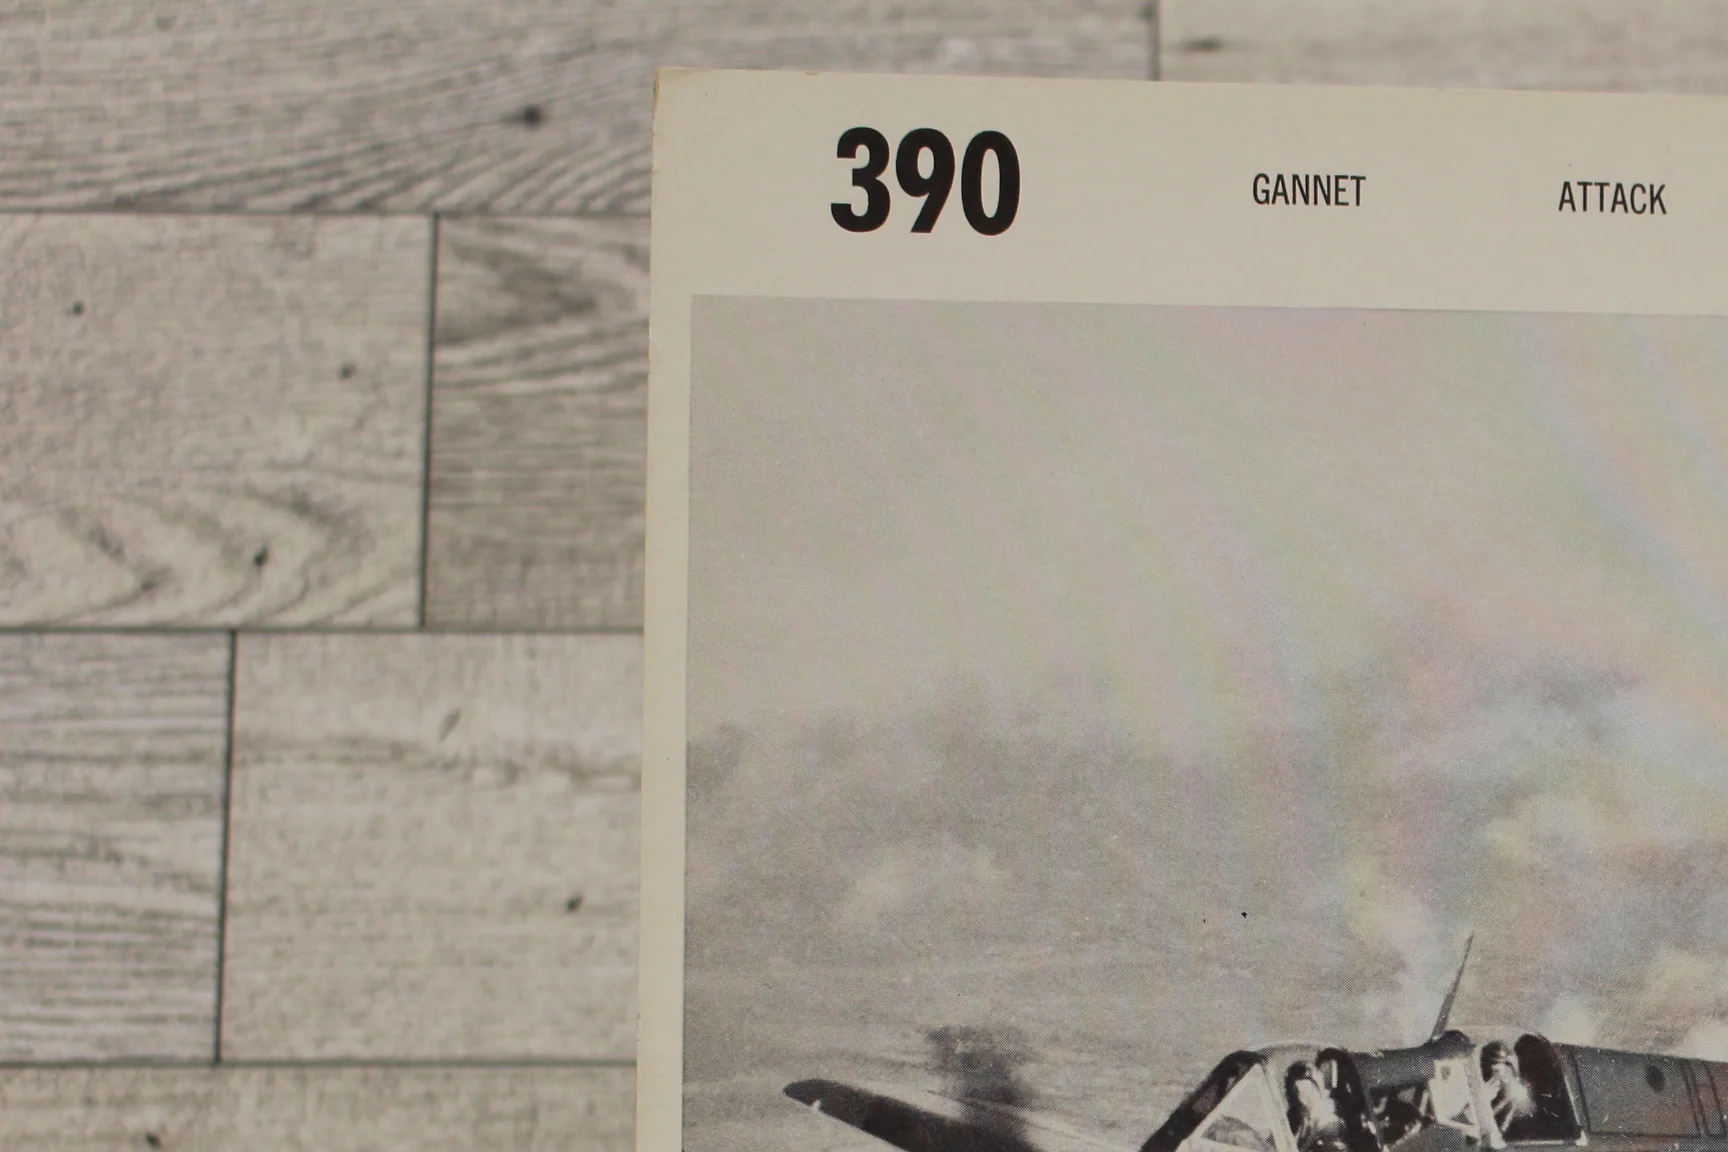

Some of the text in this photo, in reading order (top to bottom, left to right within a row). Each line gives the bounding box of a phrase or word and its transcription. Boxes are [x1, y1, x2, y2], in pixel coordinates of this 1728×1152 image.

[831, 127, 1021, 236] 390
[1252, 172, 1367, 207] GANNET
[1558, 180, 1667, 215] ATTACK
